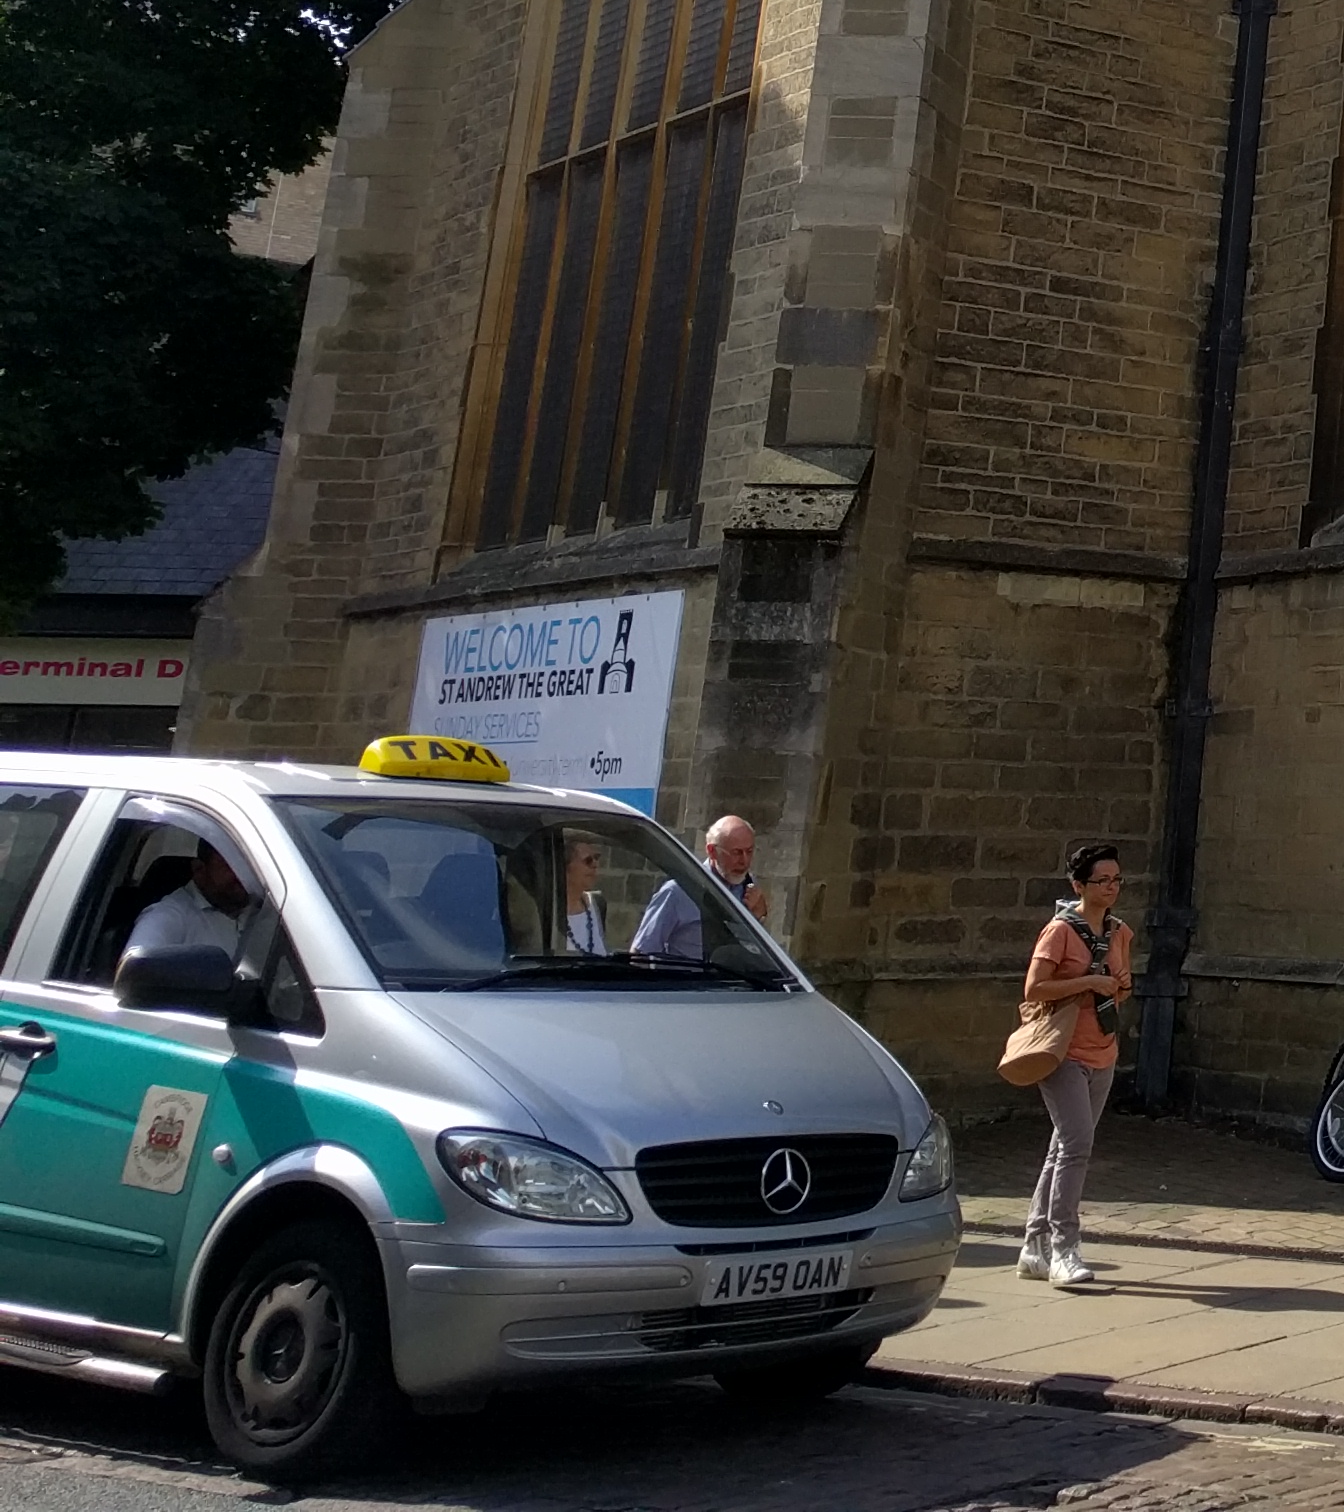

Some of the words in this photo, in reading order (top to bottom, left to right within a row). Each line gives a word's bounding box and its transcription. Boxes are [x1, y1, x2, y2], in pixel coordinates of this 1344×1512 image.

[444, 619, 562, 674] WELCOME
[567, 615, 601, 665] TO
[438, 678, 456, 705] ST
[455, 673, 517, 703] ANDREW
[517, 671, 545, 699] THE
[546, 668, 595, 698] GREAT
[482, 711, 542, 739] SERVICES
[388, 740, 502, 768] TAXI
[714, 1261, 788, 1299] AV59
[792, 1255, 843, 1291] OAN
